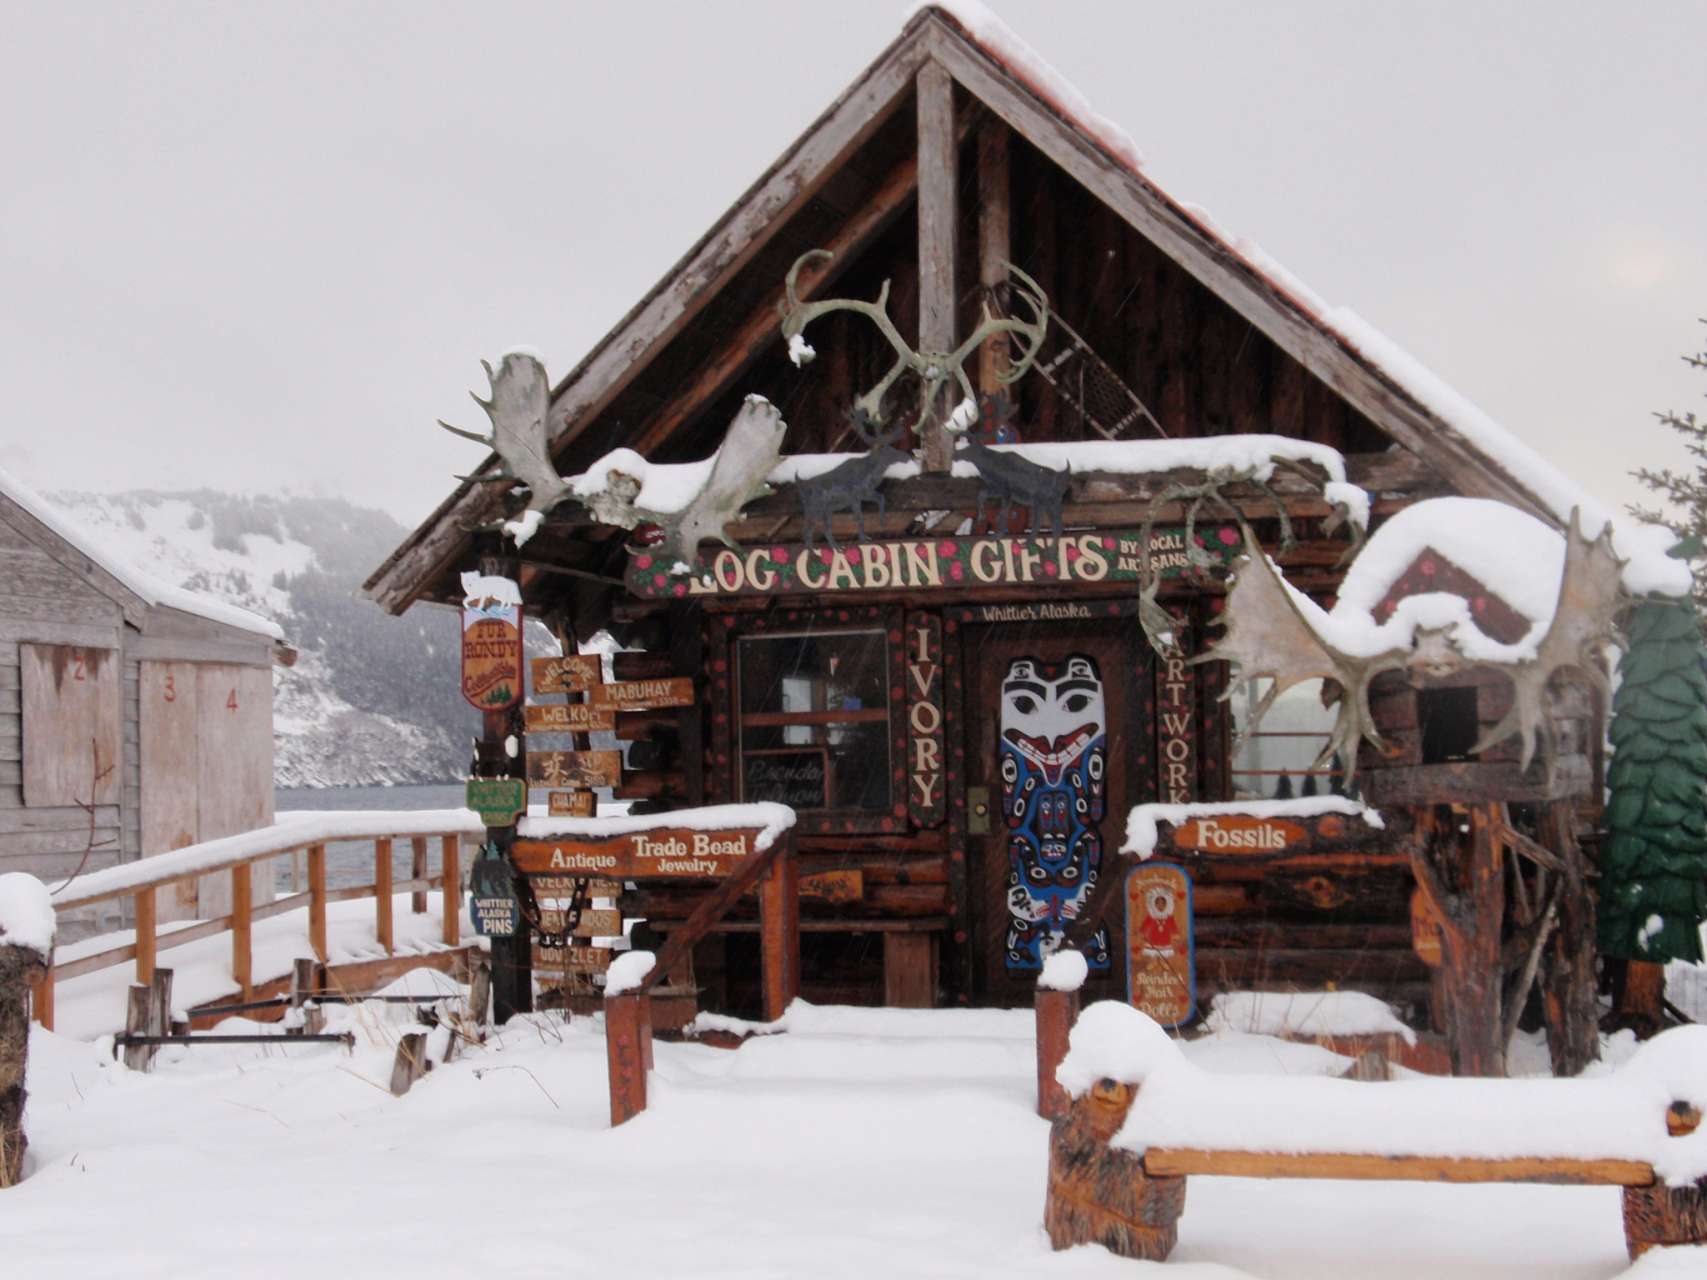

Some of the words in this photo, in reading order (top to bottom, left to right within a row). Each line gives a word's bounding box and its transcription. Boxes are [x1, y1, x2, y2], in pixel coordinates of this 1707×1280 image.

[1120, 540, 1138, 554] BY
[1147, 535, 1184, 552] OCAL
[796, 542, 942, 589] CABIN
[970, 535, 1109, 582] GIFTS
[1118, 553, 1189, 571] ARSANS
[982, 604, 1037, 621] Whittier
[1040, 605, 1091, 619] Alaska
[477, 621, 506, 638] FUR
[465, 641, 517, 658] RONDY
[74, 657, 85, 681] 2
[541, 657, 595, 685] WELCOME
[164, 676, 176, 702] 3
[606, 681, 672, 700] MABUHAY
[226, 688, 239, 713] 4
[910, 629, 940, 807] IVORY
[471, 796, 516, 807] ALASKA
[484, 811, 509, 822] PINS
[1197, 820, 1286, 849] Fossils
[631, 835, 687, 857] Trade
[692, 834, 747, 857] Bead
[550, 848, 617, 871] Antique
[658, 858, 718, 876] Jewelry
[475, 899, 514, 908] WHITTIER
[478, 909, 512, 918] ALASKA
[483, 919, 514, 934] PINS
[1139, 1001, 1180, 1017] Dolls
